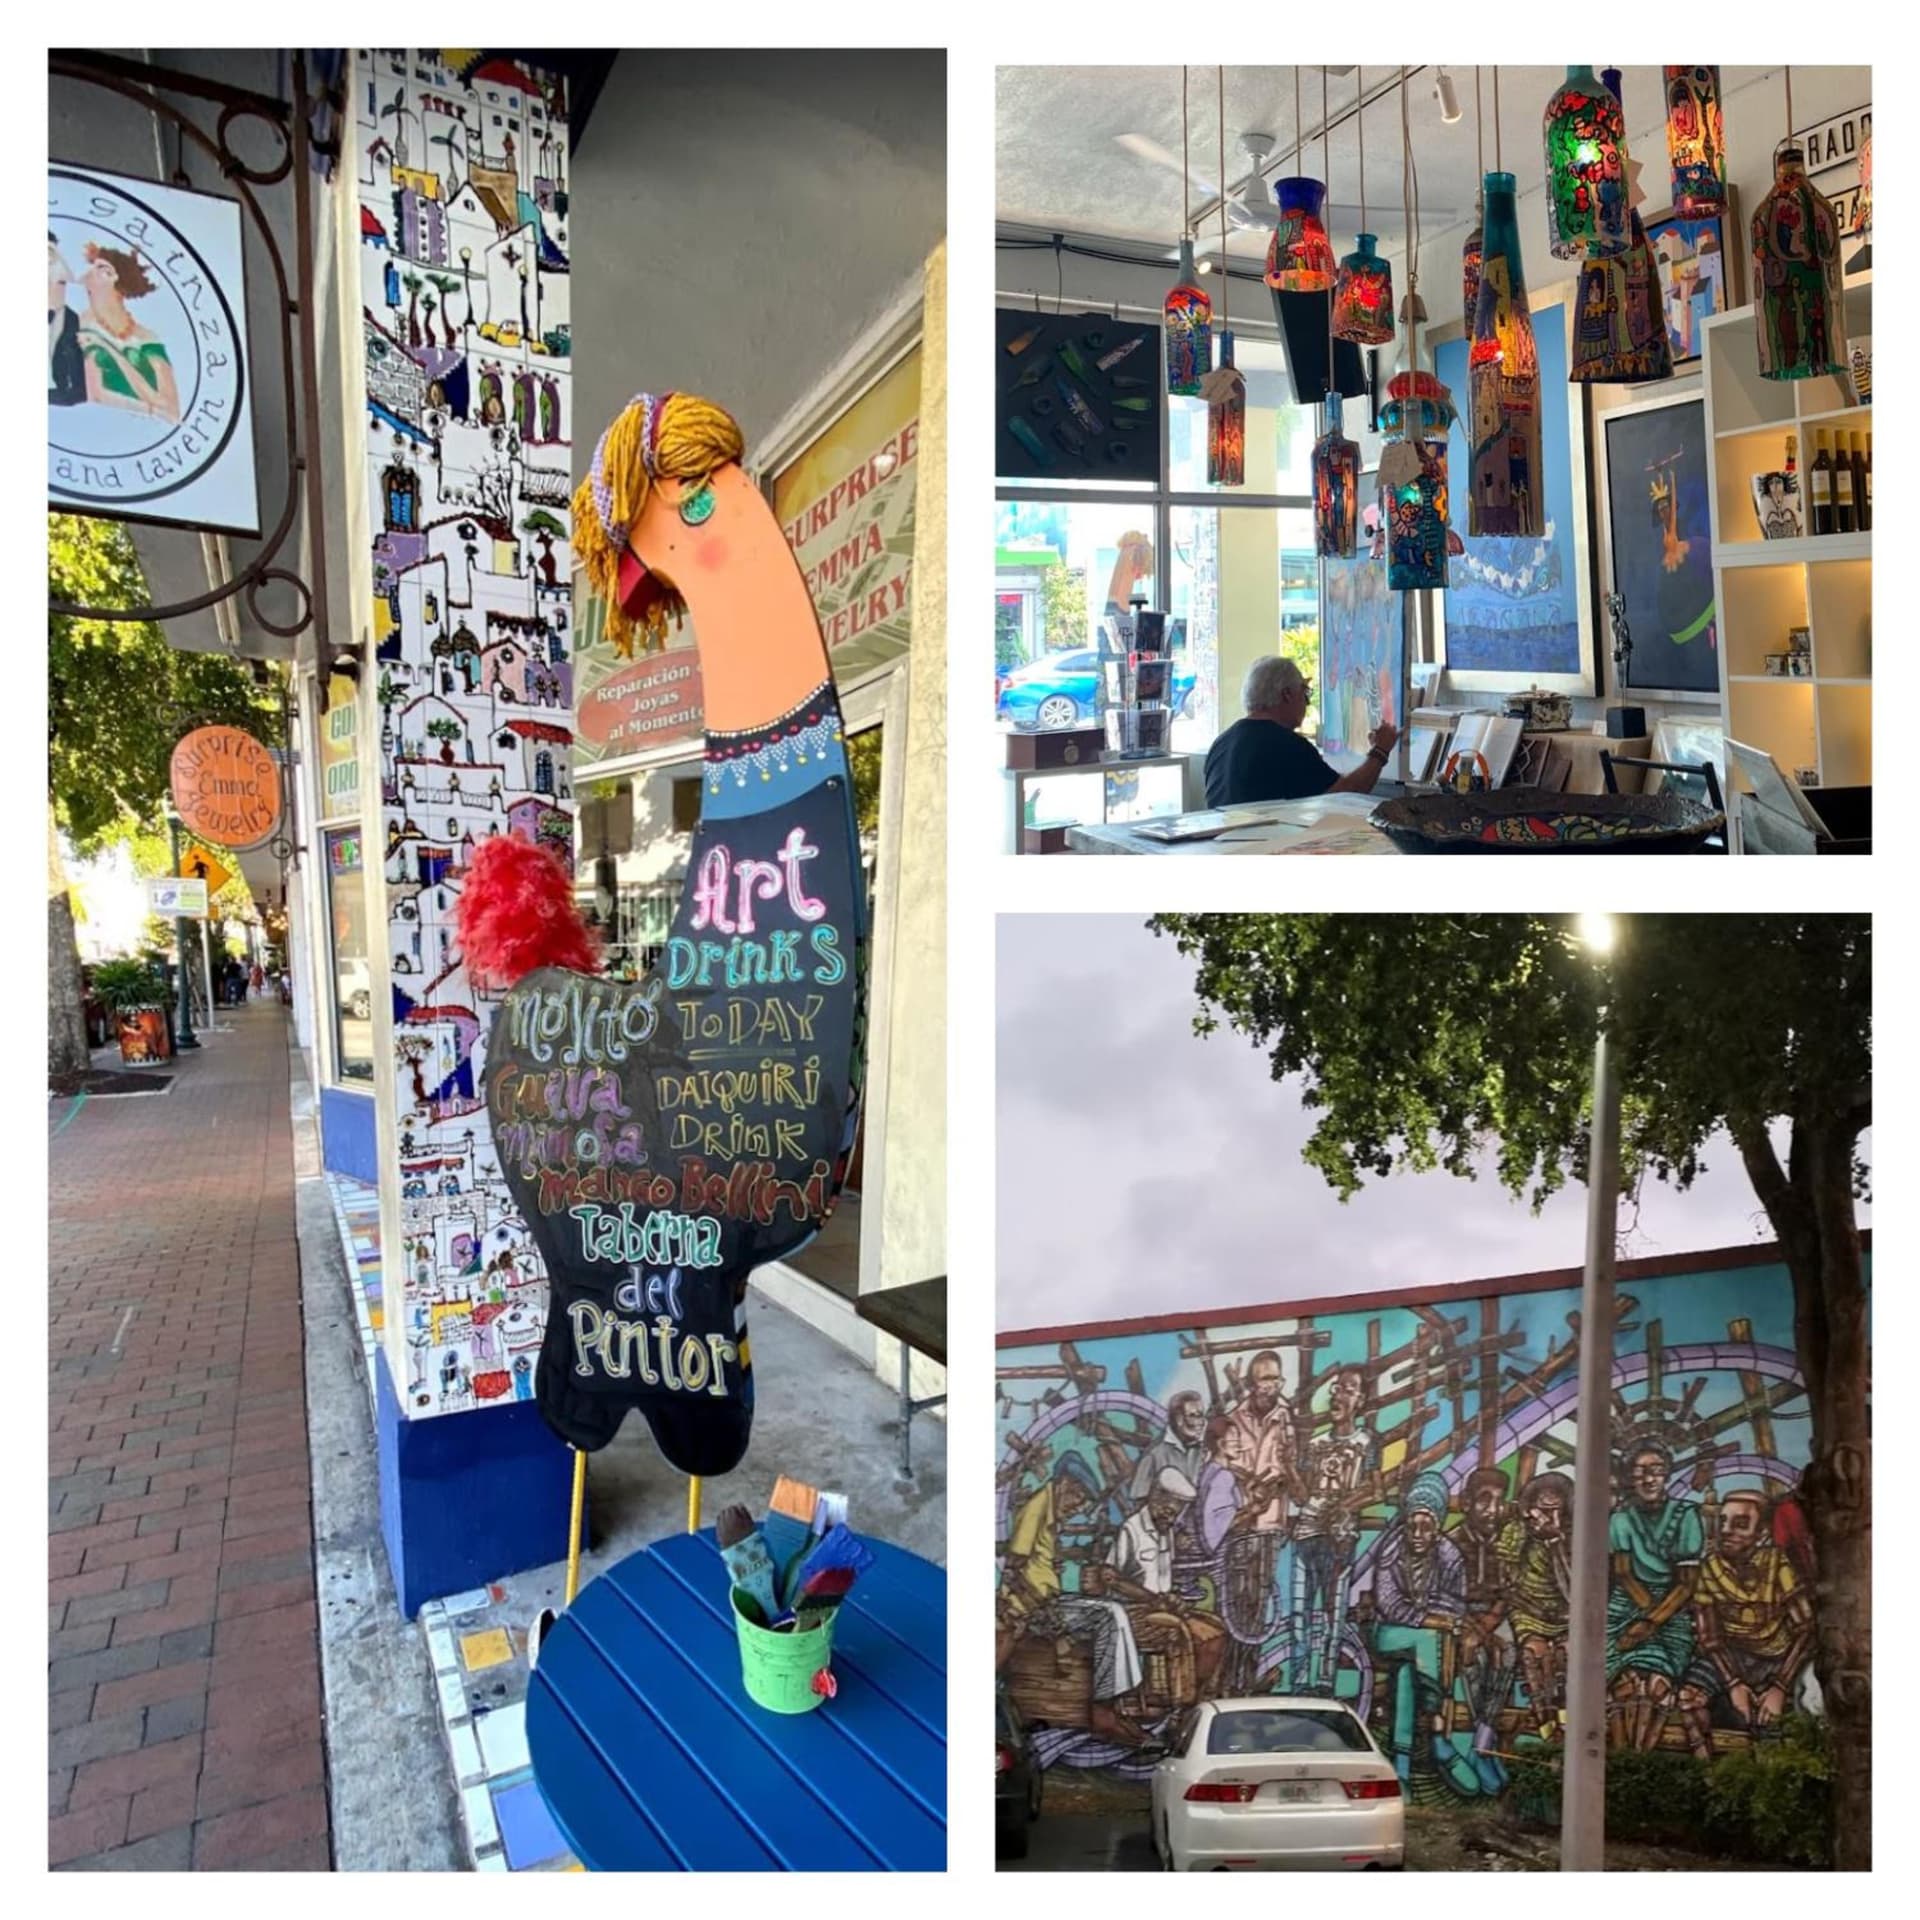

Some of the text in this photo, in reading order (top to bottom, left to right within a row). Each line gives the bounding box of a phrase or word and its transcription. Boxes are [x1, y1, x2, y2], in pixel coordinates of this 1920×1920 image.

[56, 458, 123, 489] and
[784, 419, 919, 550] SURPRISE
[806, 522, 883, 597] EMMA
[597, 663, 690, 702] Reparación
[631, 690, 679, 714] Joyas
[609, 725, 624, 740] al
[175, 735, 271, 779] Surprise
[199, 769, 262, 797] Emma
[182, 791, 273, 837] Jewelry
[690, 827, 826, 934] Art
[568, 1202, 724, 1269] Taberna
[613, 1263, 685, 1321] del
[567, 1299, 738, 1397] Pintor
